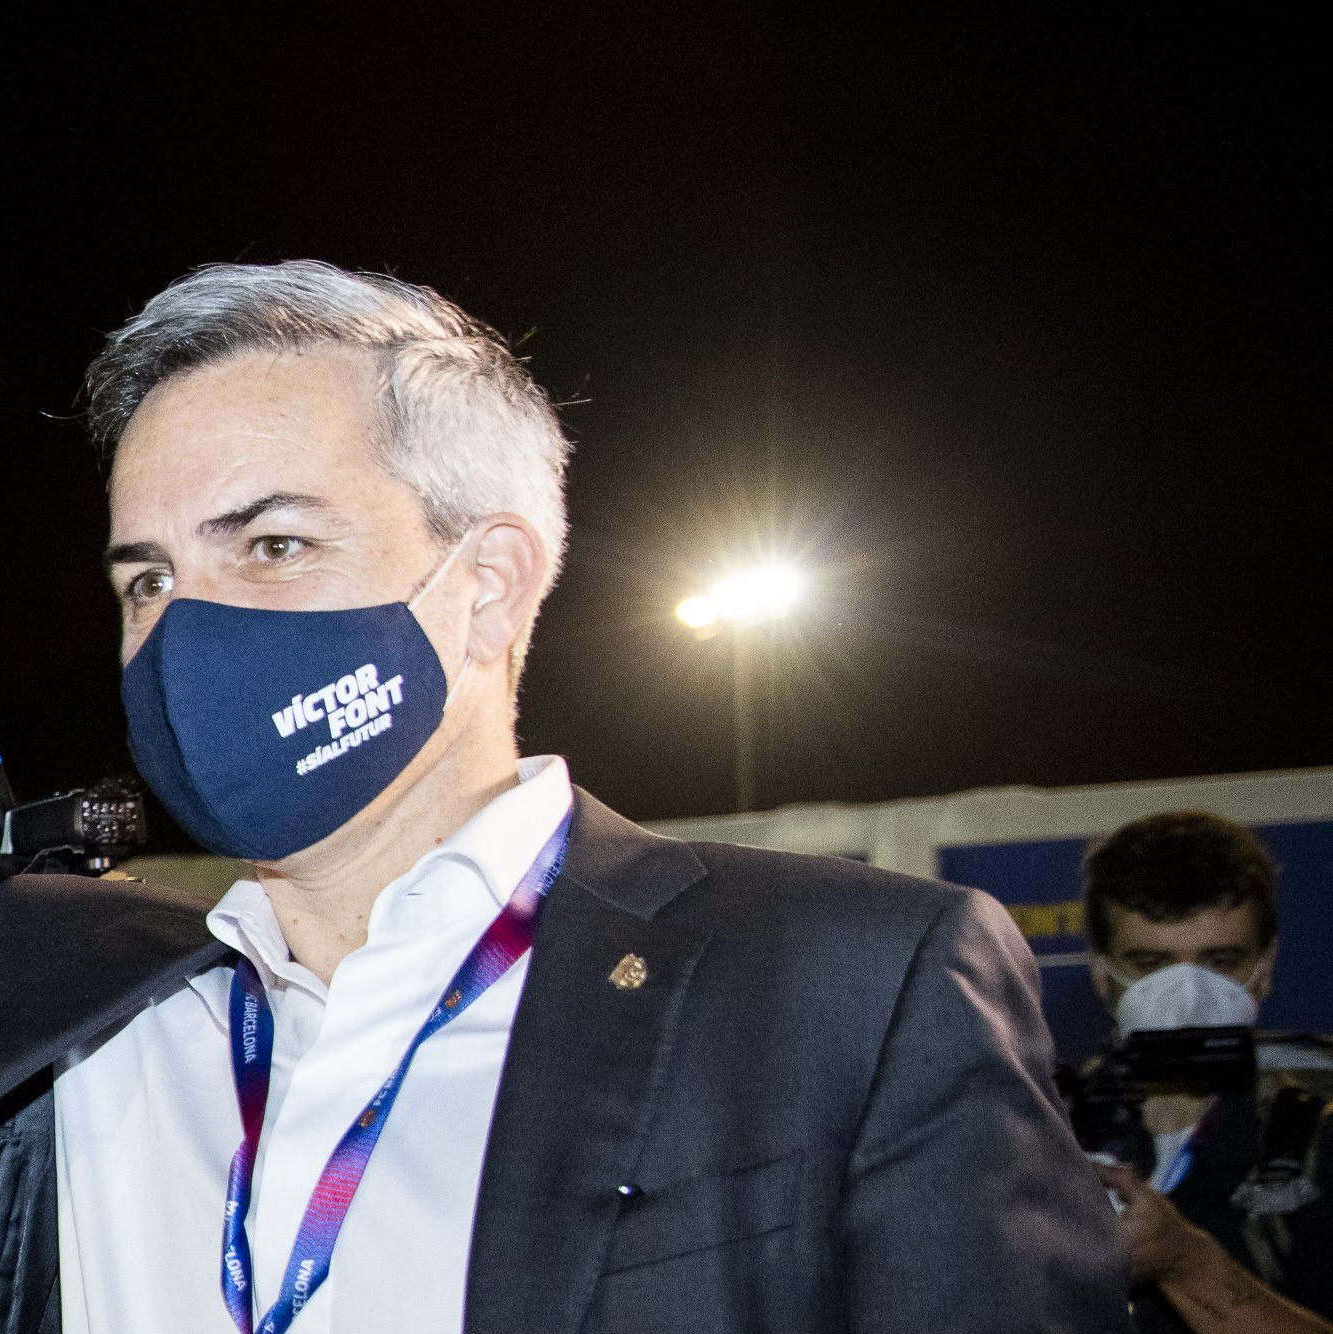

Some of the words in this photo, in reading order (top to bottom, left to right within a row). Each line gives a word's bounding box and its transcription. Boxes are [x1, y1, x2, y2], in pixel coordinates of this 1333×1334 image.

[271, 663, 380, 738] VÍCTOR
[327, 674, 404, 739] FONT
[295, 712, 393, 776] #SÍALFUTUR
[242, 1000, 259, 1064] BARCELONA
